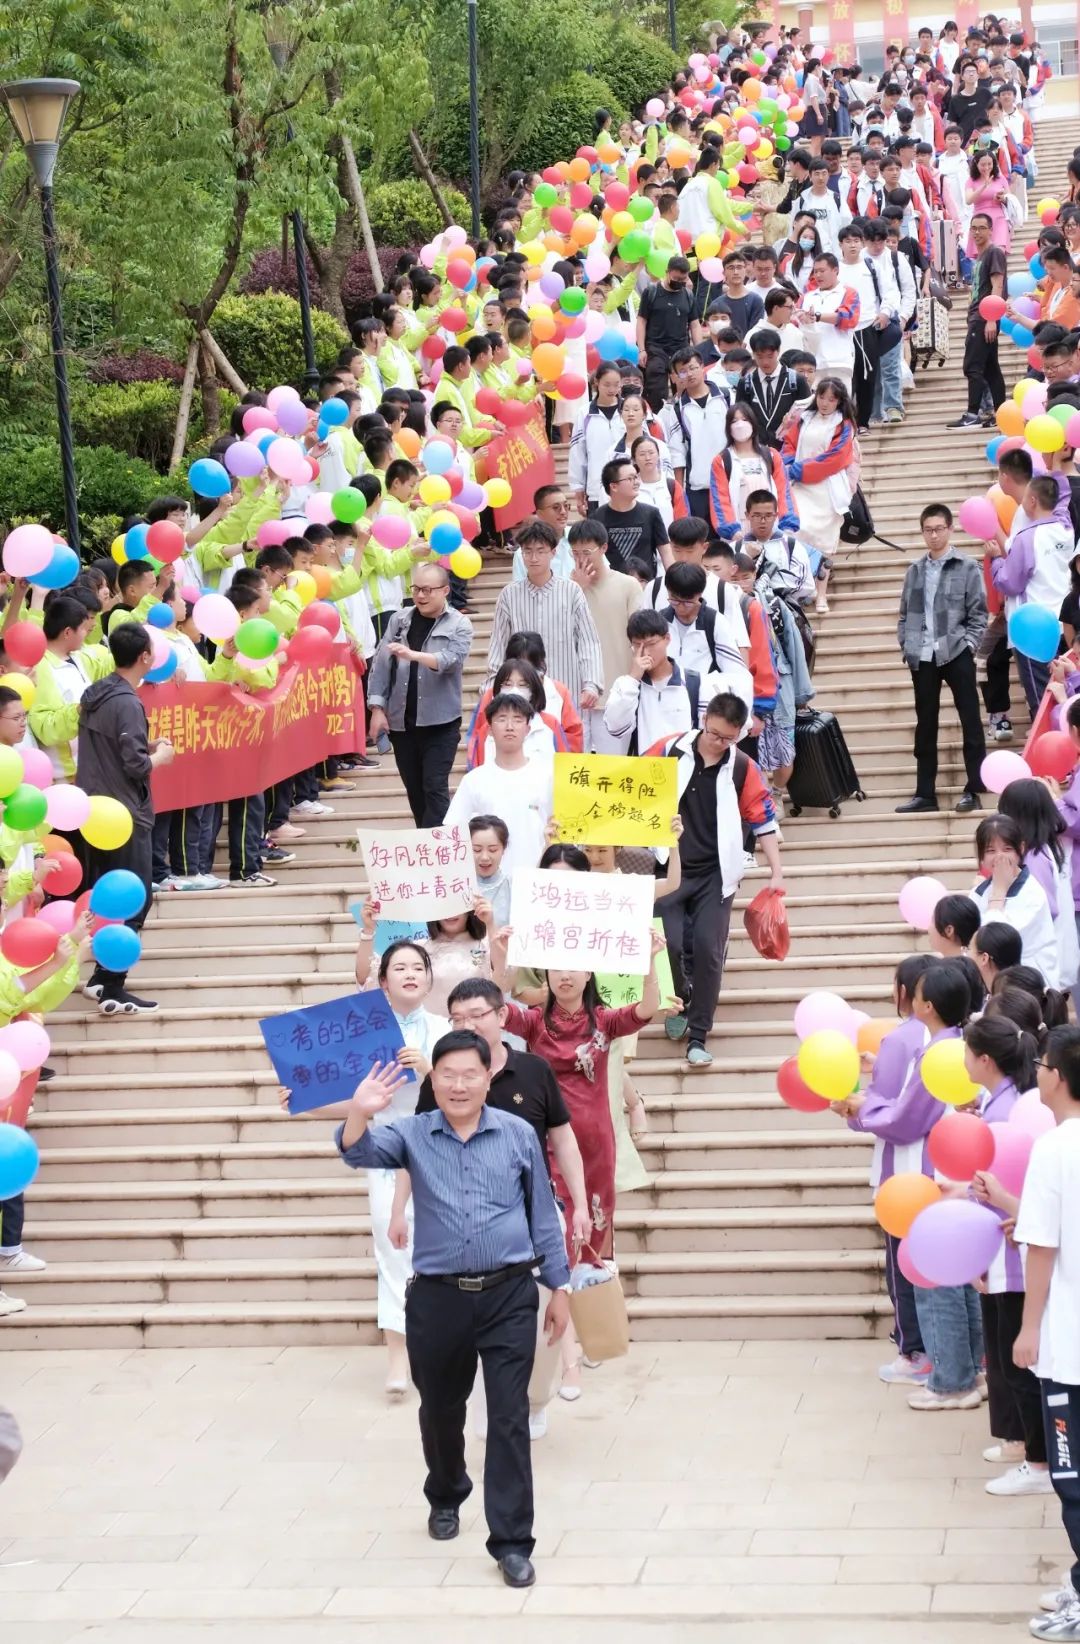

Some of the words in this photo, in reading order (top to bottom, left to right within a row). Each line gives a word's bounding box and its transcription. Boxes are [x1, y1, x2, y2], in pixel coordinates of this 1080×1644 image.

[569, 765, 657, 800] 旗开得胜
[585, 801, 662, 830] 金榜题名
[369, 840, 468, 868] 好风凭借力
[531, 882, 638, 915] 鸿运当头
[533, 919, 641, 959] 蟾宫折桂
[289, 1007, 390, 1052] 考的全会
[1055, 1418, 1071, 1469] MAGIC
